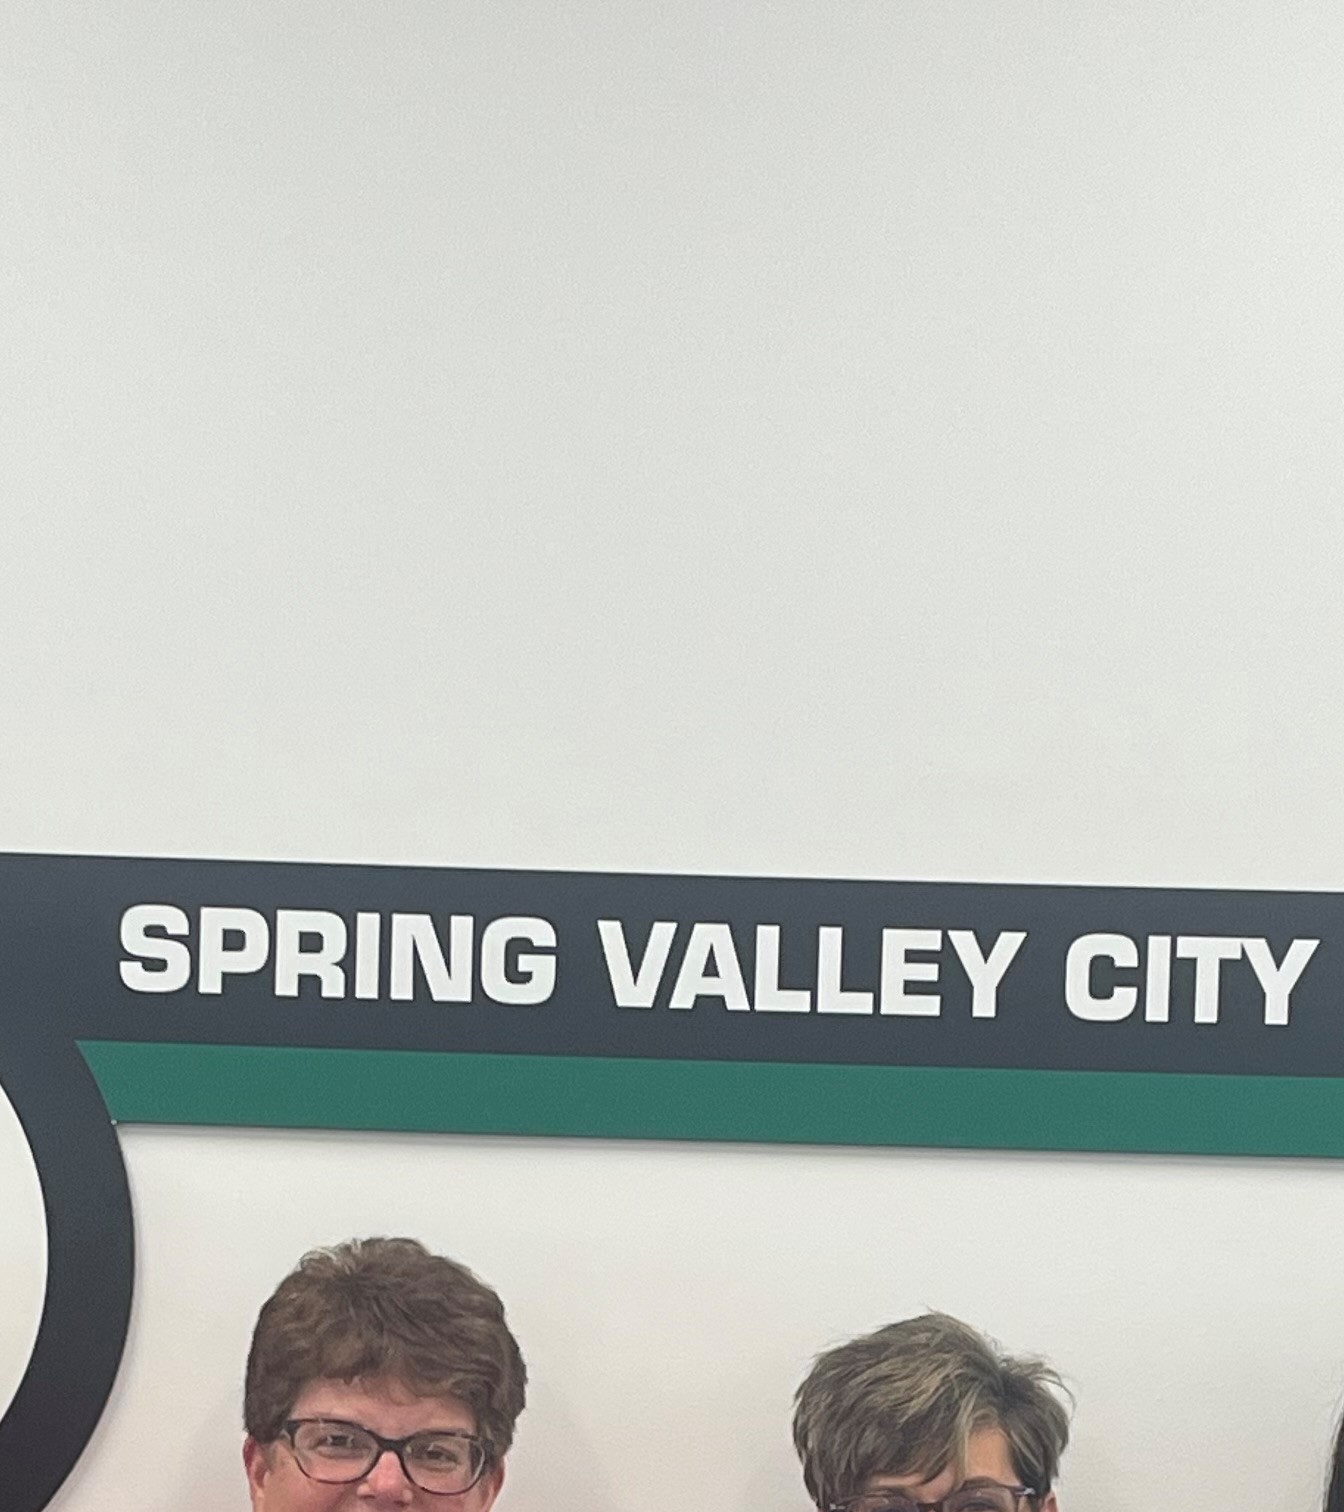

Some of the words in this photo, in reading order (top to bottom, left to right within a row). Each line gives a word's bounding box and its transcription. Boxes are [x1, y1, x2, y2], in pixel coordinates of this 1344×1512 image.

[119, 904, 557, 1005] SPRING
[597, 919, 1027, 1018] VALLEY
[1065, 933, 1320, 1026] CITY
